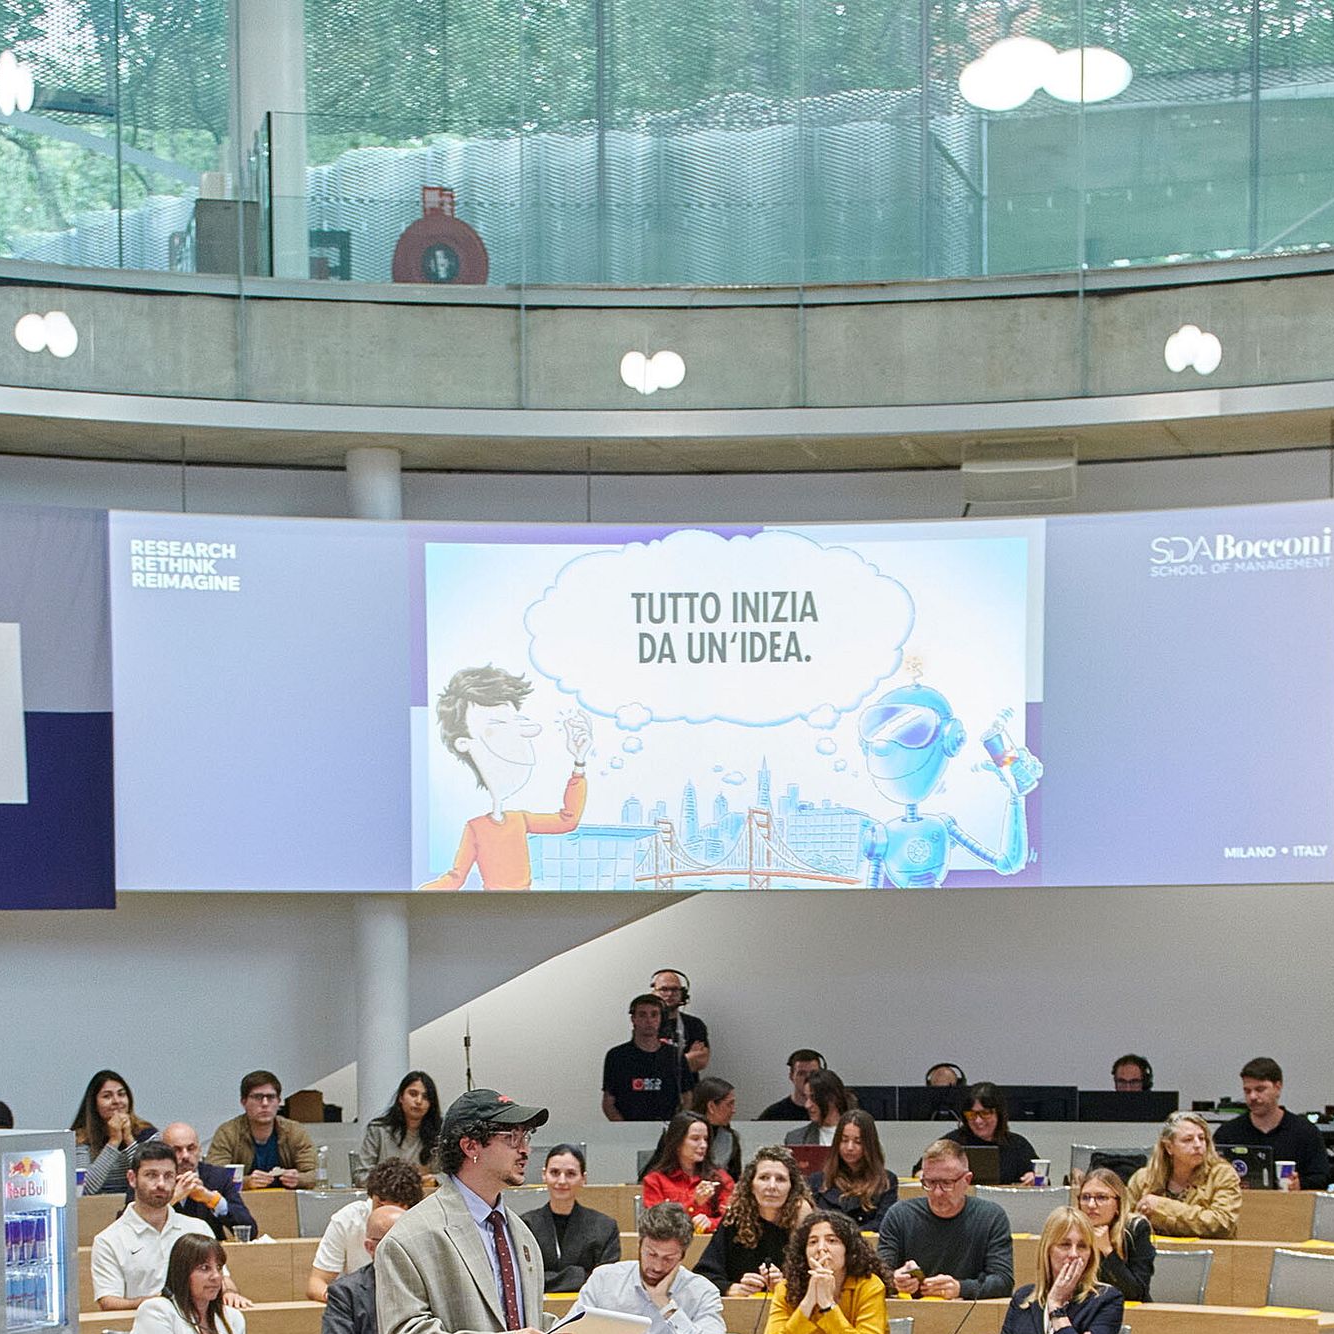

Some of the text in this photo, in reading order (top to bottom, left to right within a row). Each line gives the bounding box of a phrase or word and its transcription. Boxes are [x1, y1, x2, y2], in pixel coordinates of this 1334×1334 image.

[130, 539, 236, 559] RESEARCH
[131, 556, 218, 574] RETHINK
[1150, 556, 1332, 578] SCHOOL OF MANAGEMENT
[131, 572, 241, 592] REIMAGINE
[631, 591, 818, 624] TUTTO INIZIA
[639, 631, 812, 664] DA UN'IDEA.
[1224, 845, 1328, 858] MILANO ITALY
